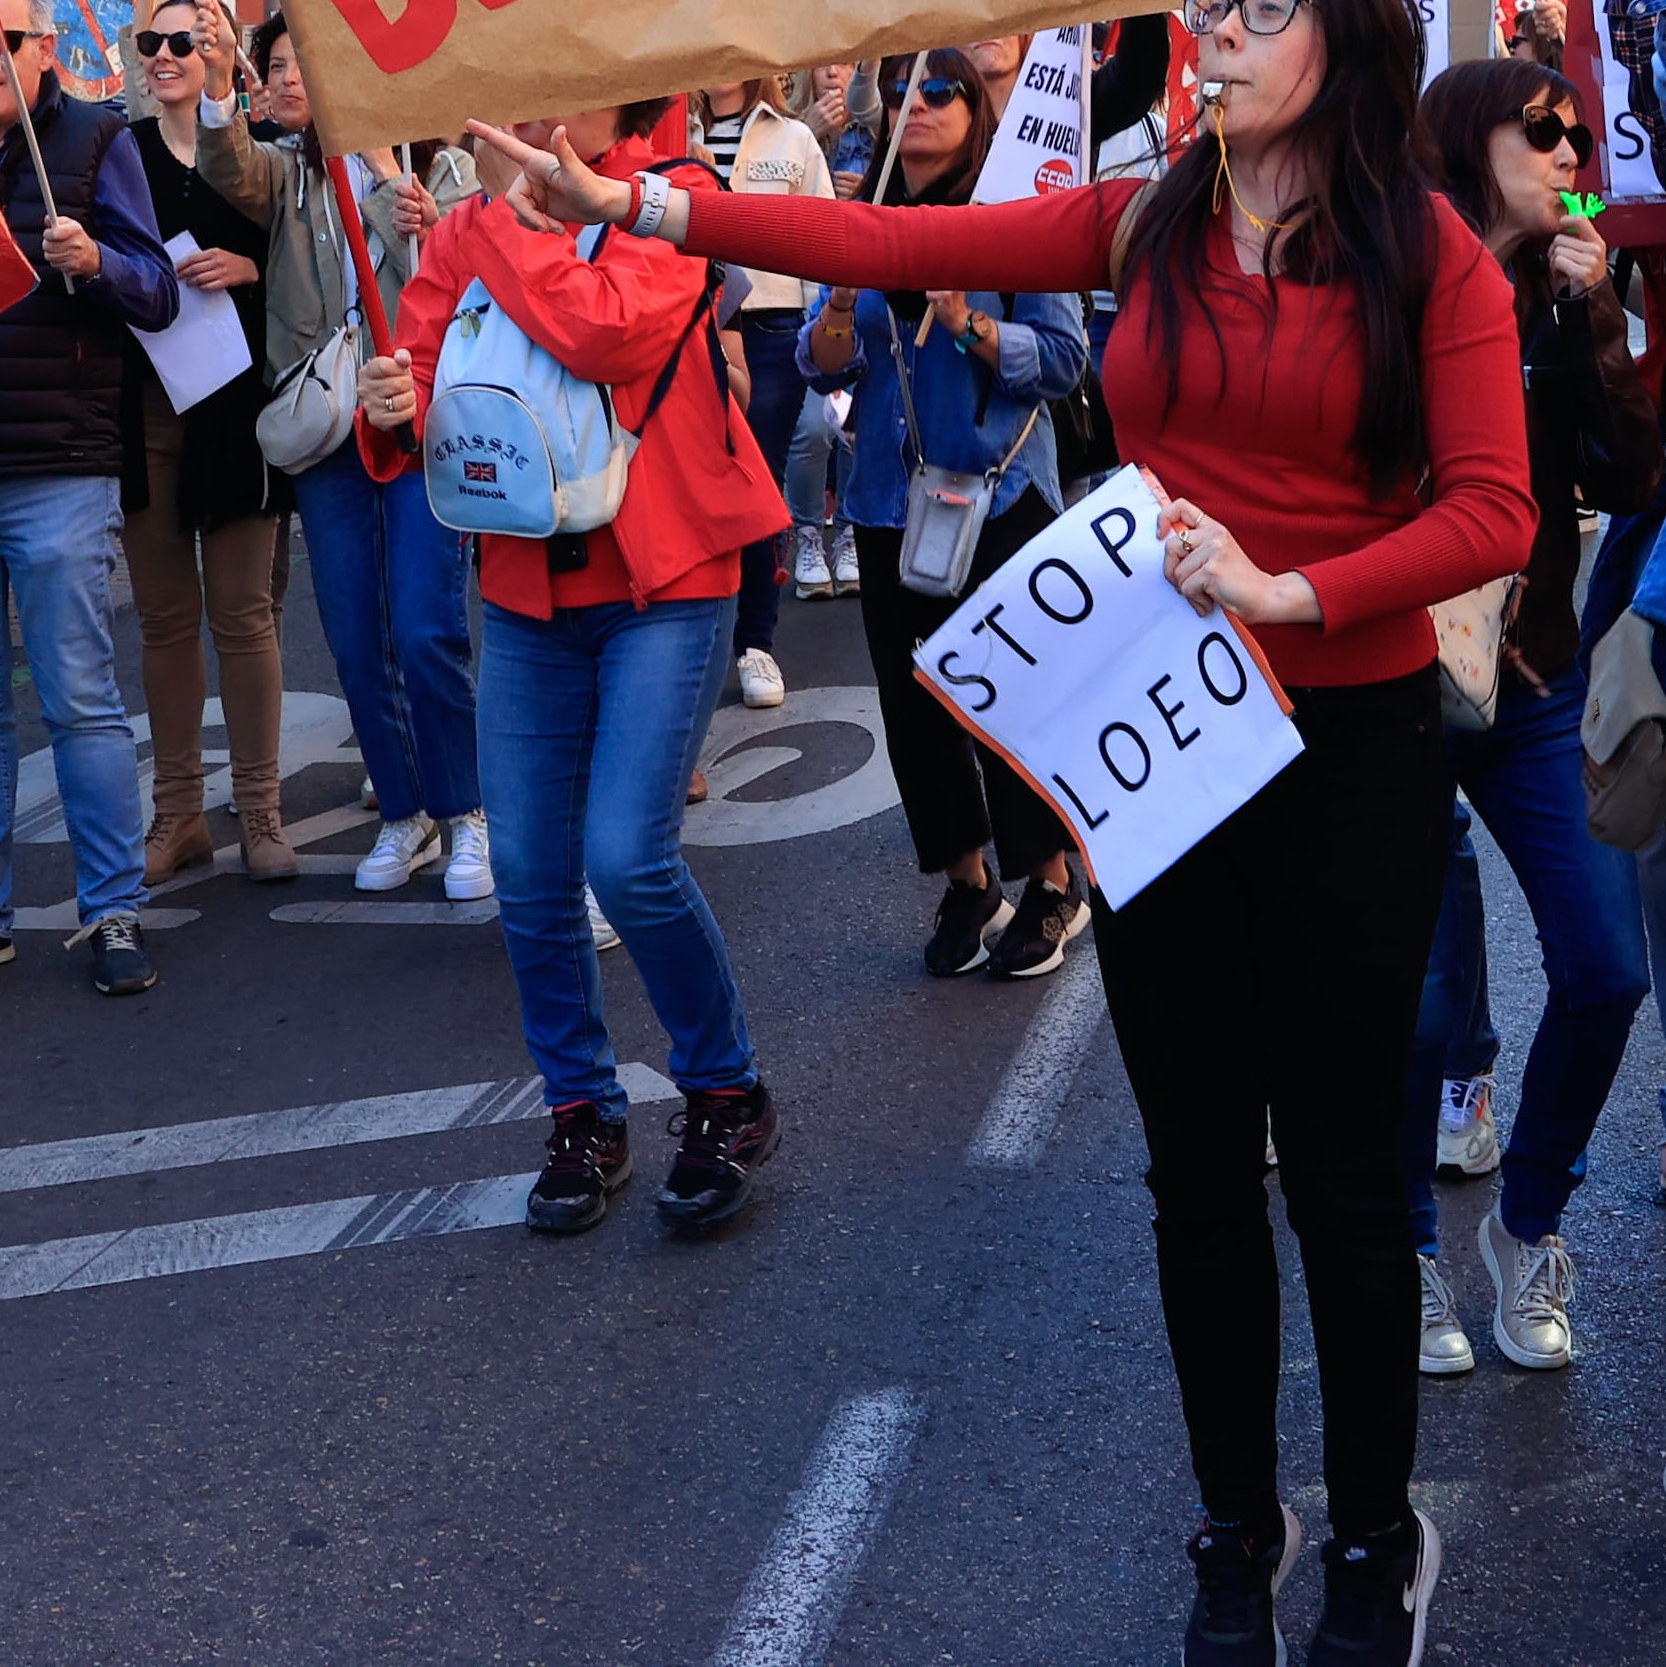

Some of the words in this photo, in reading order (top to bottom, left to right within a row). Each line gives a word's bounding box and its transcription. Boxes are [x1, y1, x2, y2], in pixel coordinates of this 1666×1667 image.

[1024, 62, 1067, 97] ESTÁ
[1017, 114, 1040, 146] EN
[458, 485, 508, 502] Reebok
[937, 506, 1137, 713] STOP
[1051, 631, 1248, 832] LOEO
